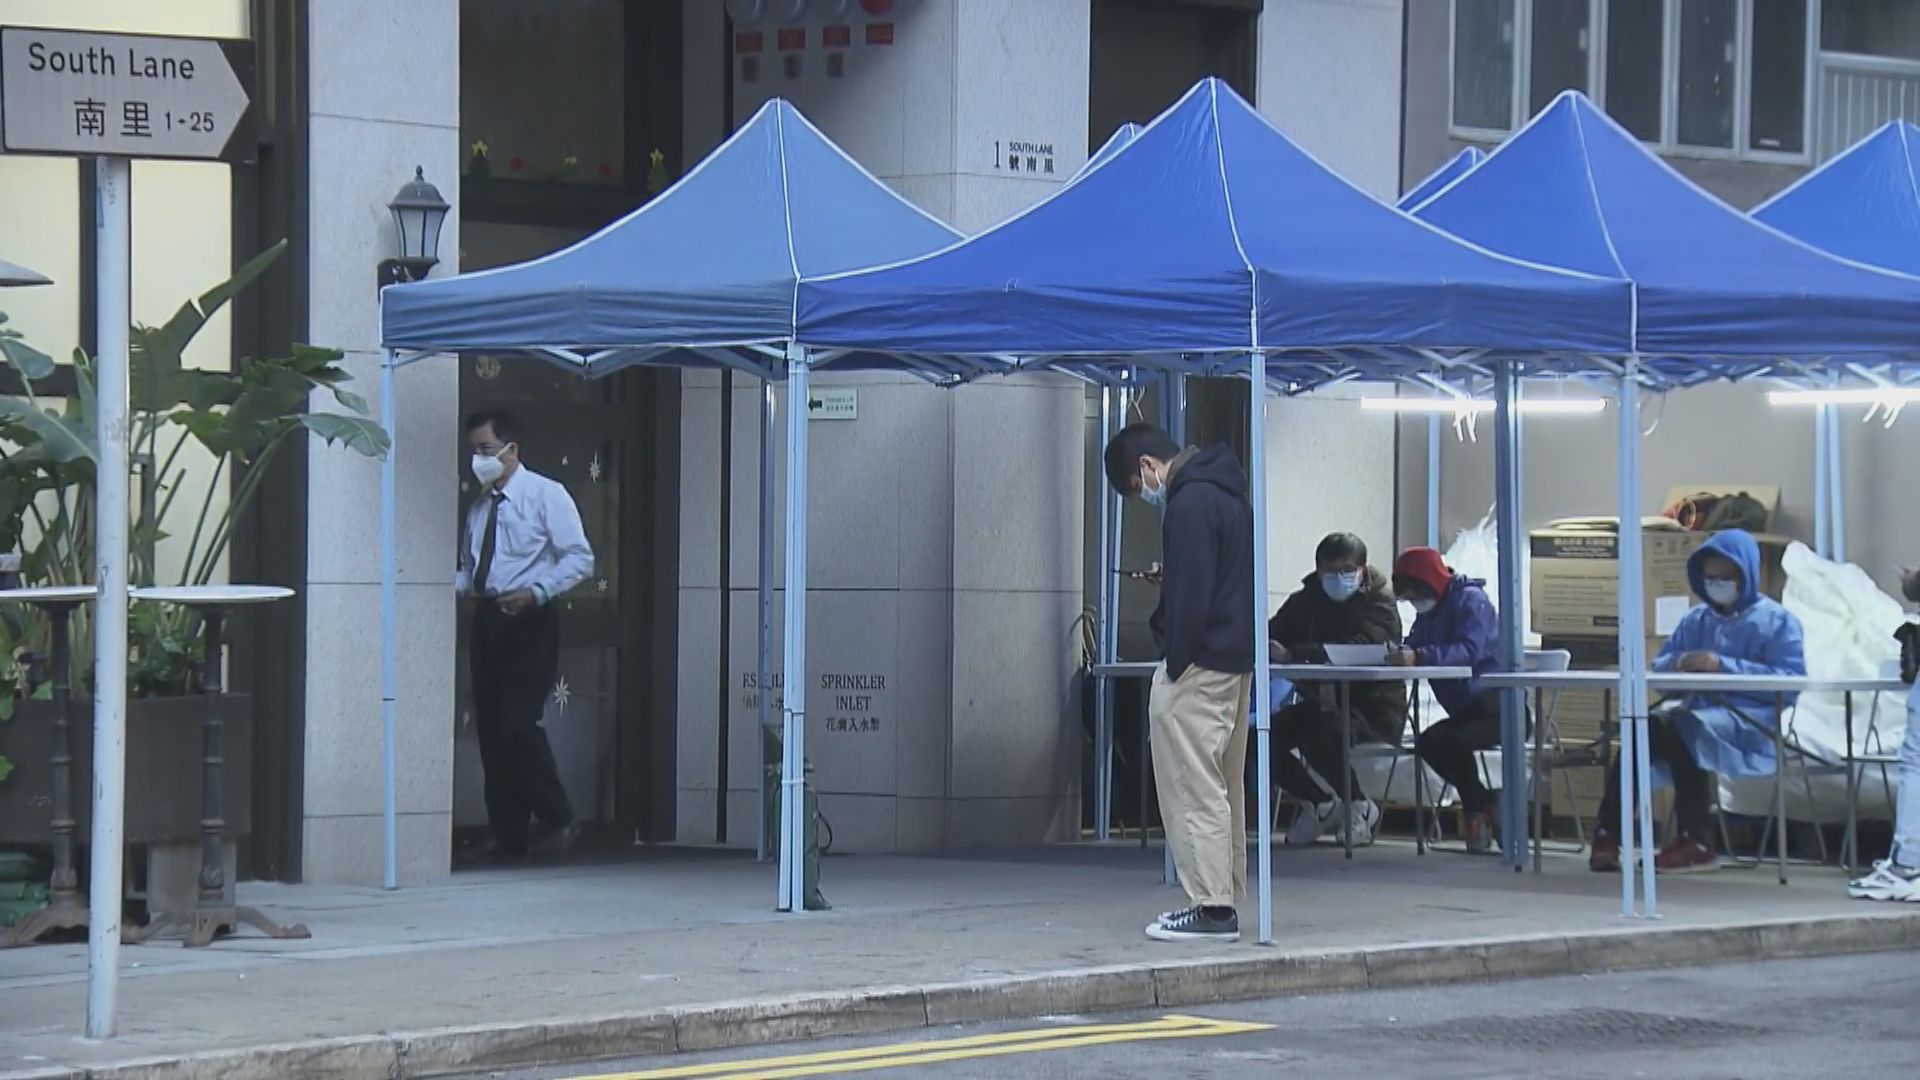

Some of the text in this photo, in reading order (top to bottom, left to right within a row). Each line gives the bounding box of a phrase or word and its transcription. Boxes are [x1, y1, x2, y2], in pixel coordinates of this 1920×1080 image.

[28, 42, 195, 79] South Lane
[74, 98, 215, 137] 南里 1-25
[1009, 142, 1053, 155] SOUTH LANE
[821, 674, 886, 689] SPRINKLER
[836, 695, 872, 711] INLET
